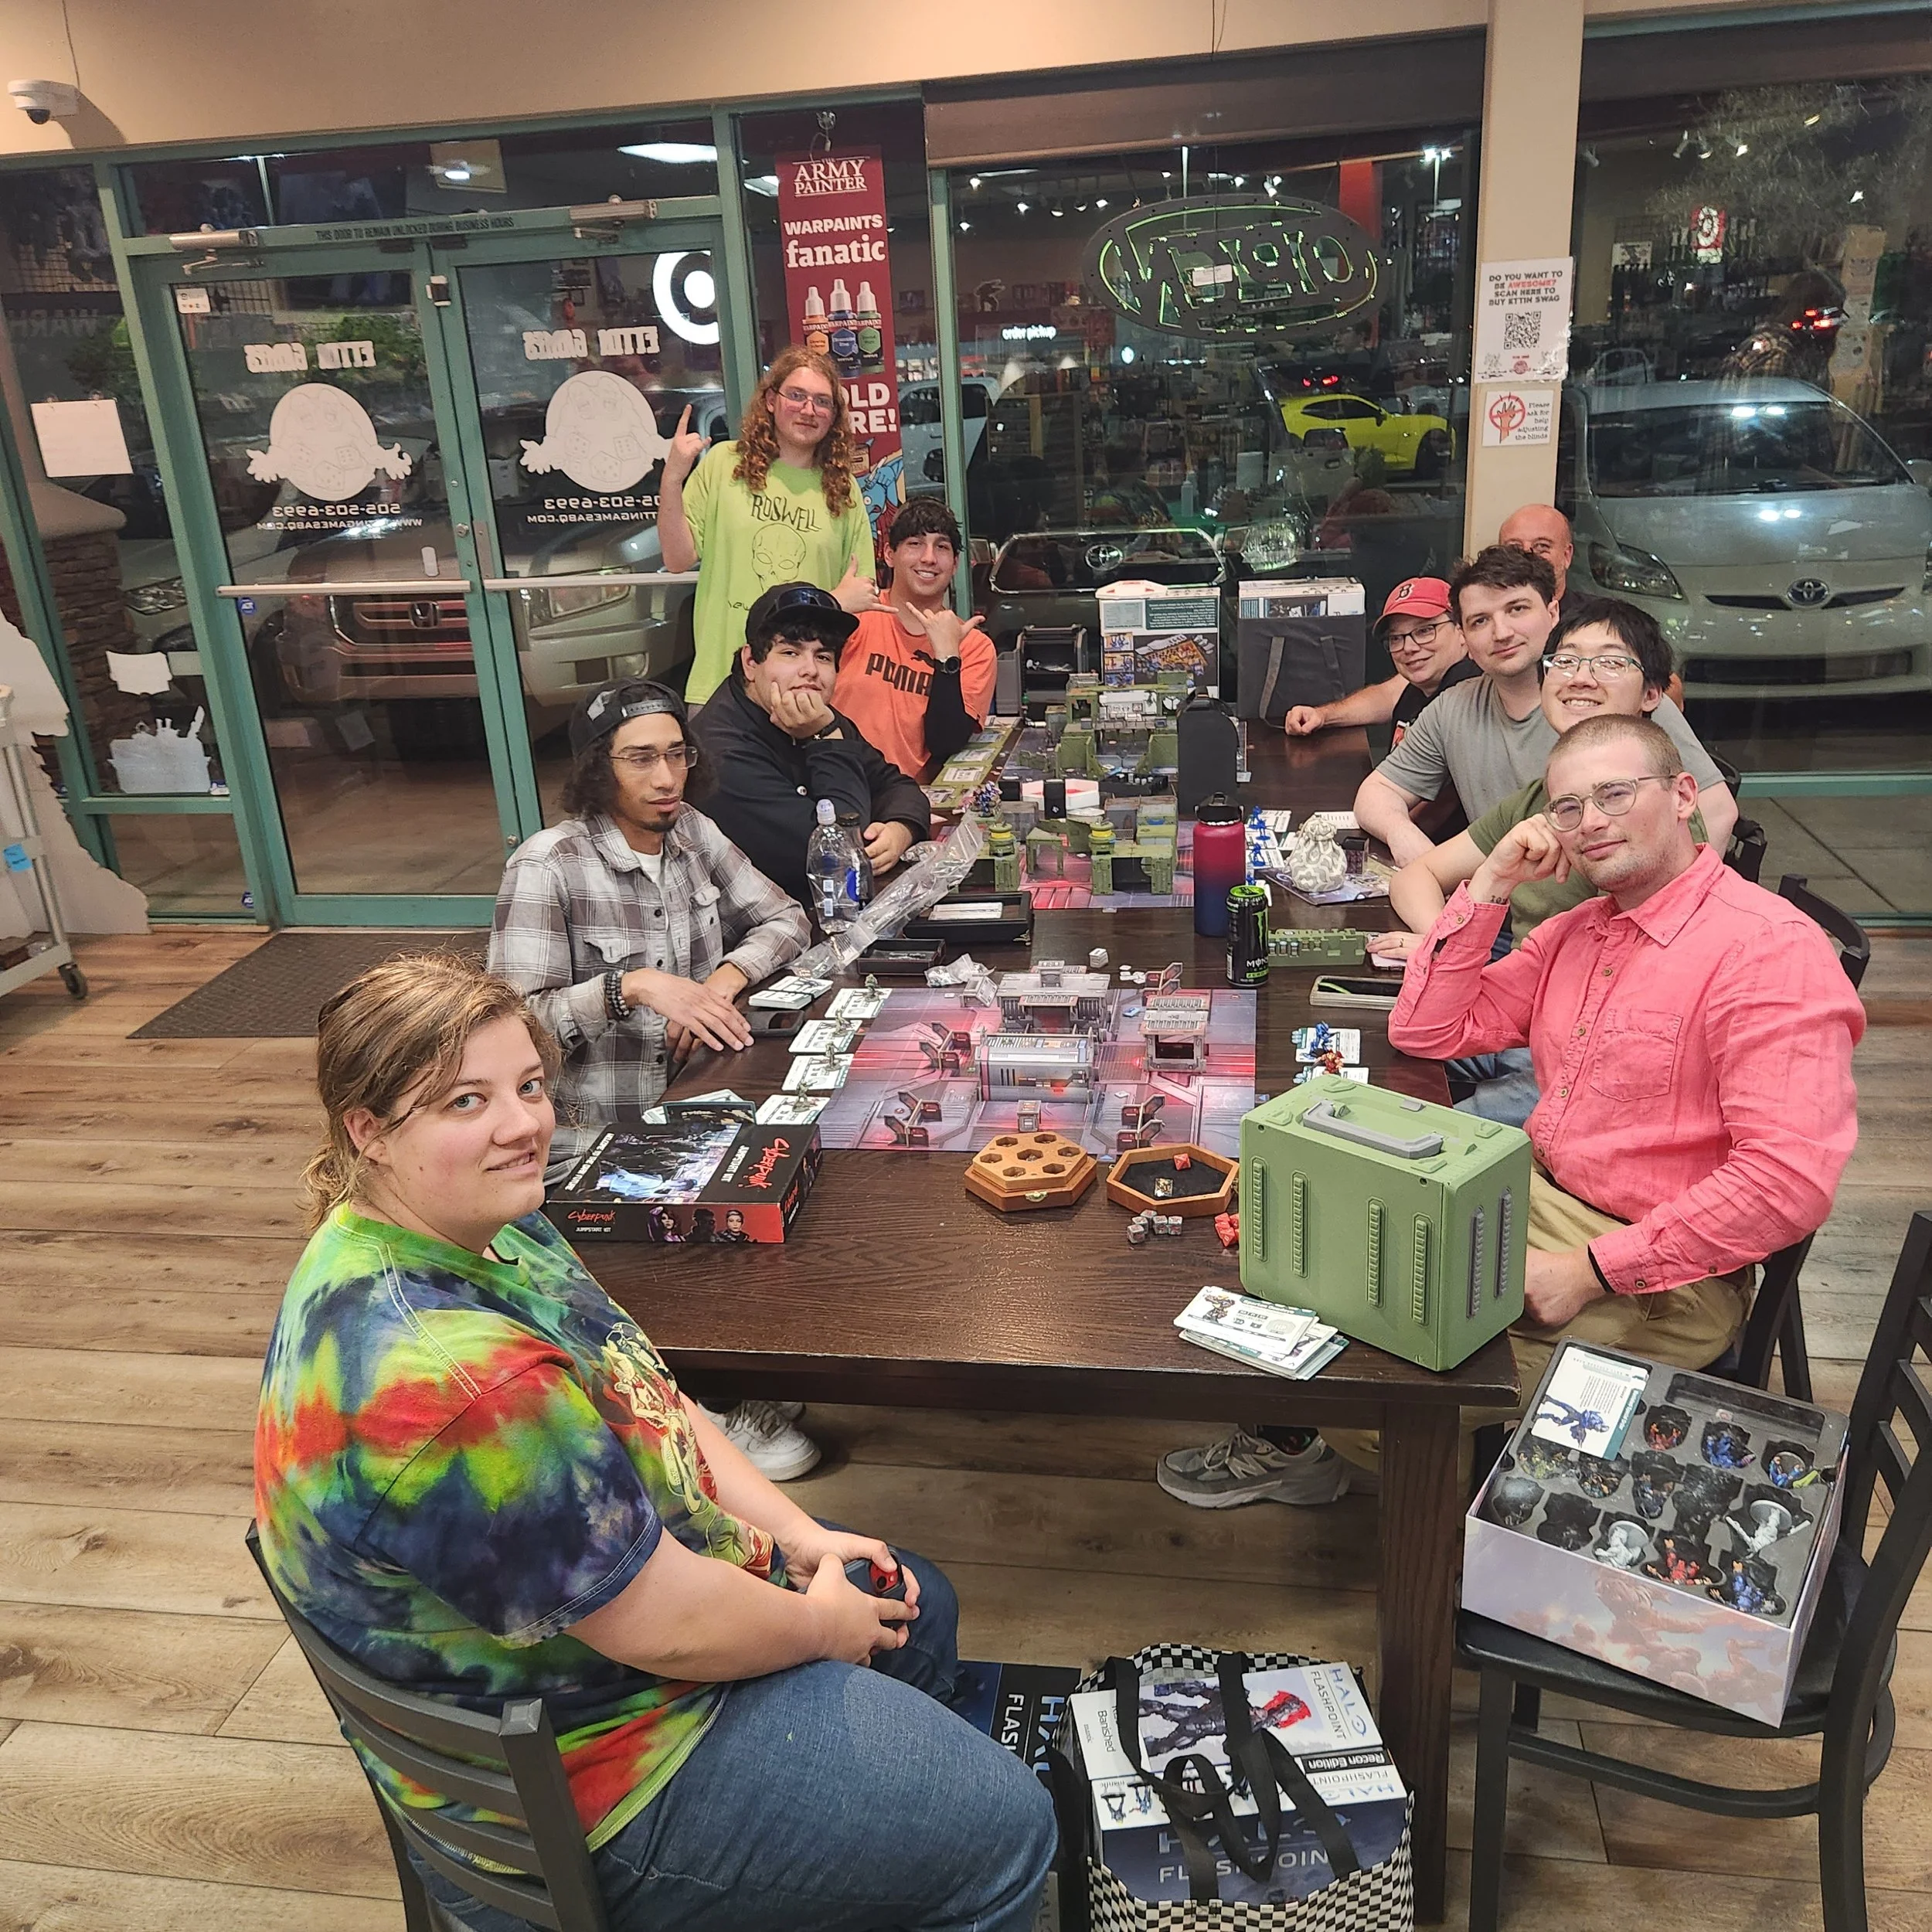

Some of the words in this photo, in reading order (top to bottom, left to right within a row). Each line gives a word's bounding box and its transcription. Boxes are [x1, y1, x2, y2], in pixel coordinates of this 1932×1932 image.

[794, 158, 865, 182] ARMY
[794, 177, 867, 194] PAINTER
[784, 214, 883, 235] WARPAINTS
[786, 233, 886, 268] fanatic
[1508, 279, 1556, 289] AWESOME?
[751, 493, 822, 532] ROSWELL
[1395, 583, 1412, 600] B
[865, 653, 933, 696] PUMA
[744, 1138, 790, 1189] Cyberpunk
[567, 1209, 616, 1223] Cyberpunk
[1311, 1671, 1346, 1740] FLASHPOINT
[1328, 1668, 1367, 1737] HALO
[1097, 1709, 1117, 1753] Banished
[1308, 1758, 1348, 1769] Edition
[1349, 1753, 1386, 1765] Recon
[1314, 1770, 1389, 1785] FLASHPOINT
[1320, 1783, 1395, 1801] HALO
